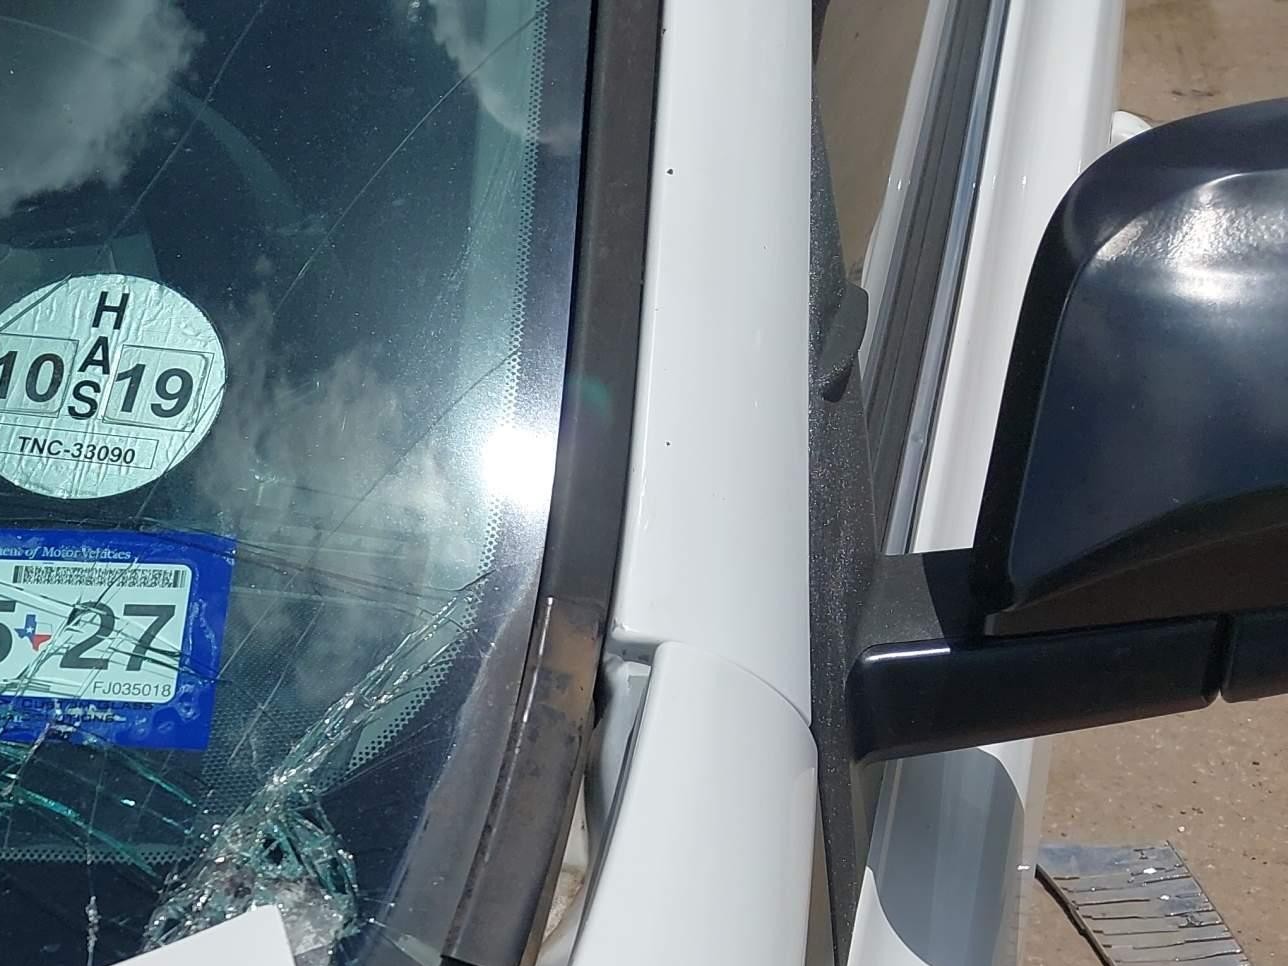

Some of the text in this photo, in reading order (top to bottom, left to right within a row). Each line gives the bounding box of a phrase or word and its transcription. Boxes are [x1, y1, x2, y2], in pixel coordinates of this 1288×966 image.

[115, 363, 194, 418] 19
[17, 436, 136, 465] TNC-33090
[25, 545, 39, 558] of
[42, 546, 80, 558] Motor
[81, 547, 131, 560] Vehicles
[59, 600, 176, 672] 27
[92, 681, 172, 698] FJ035018
